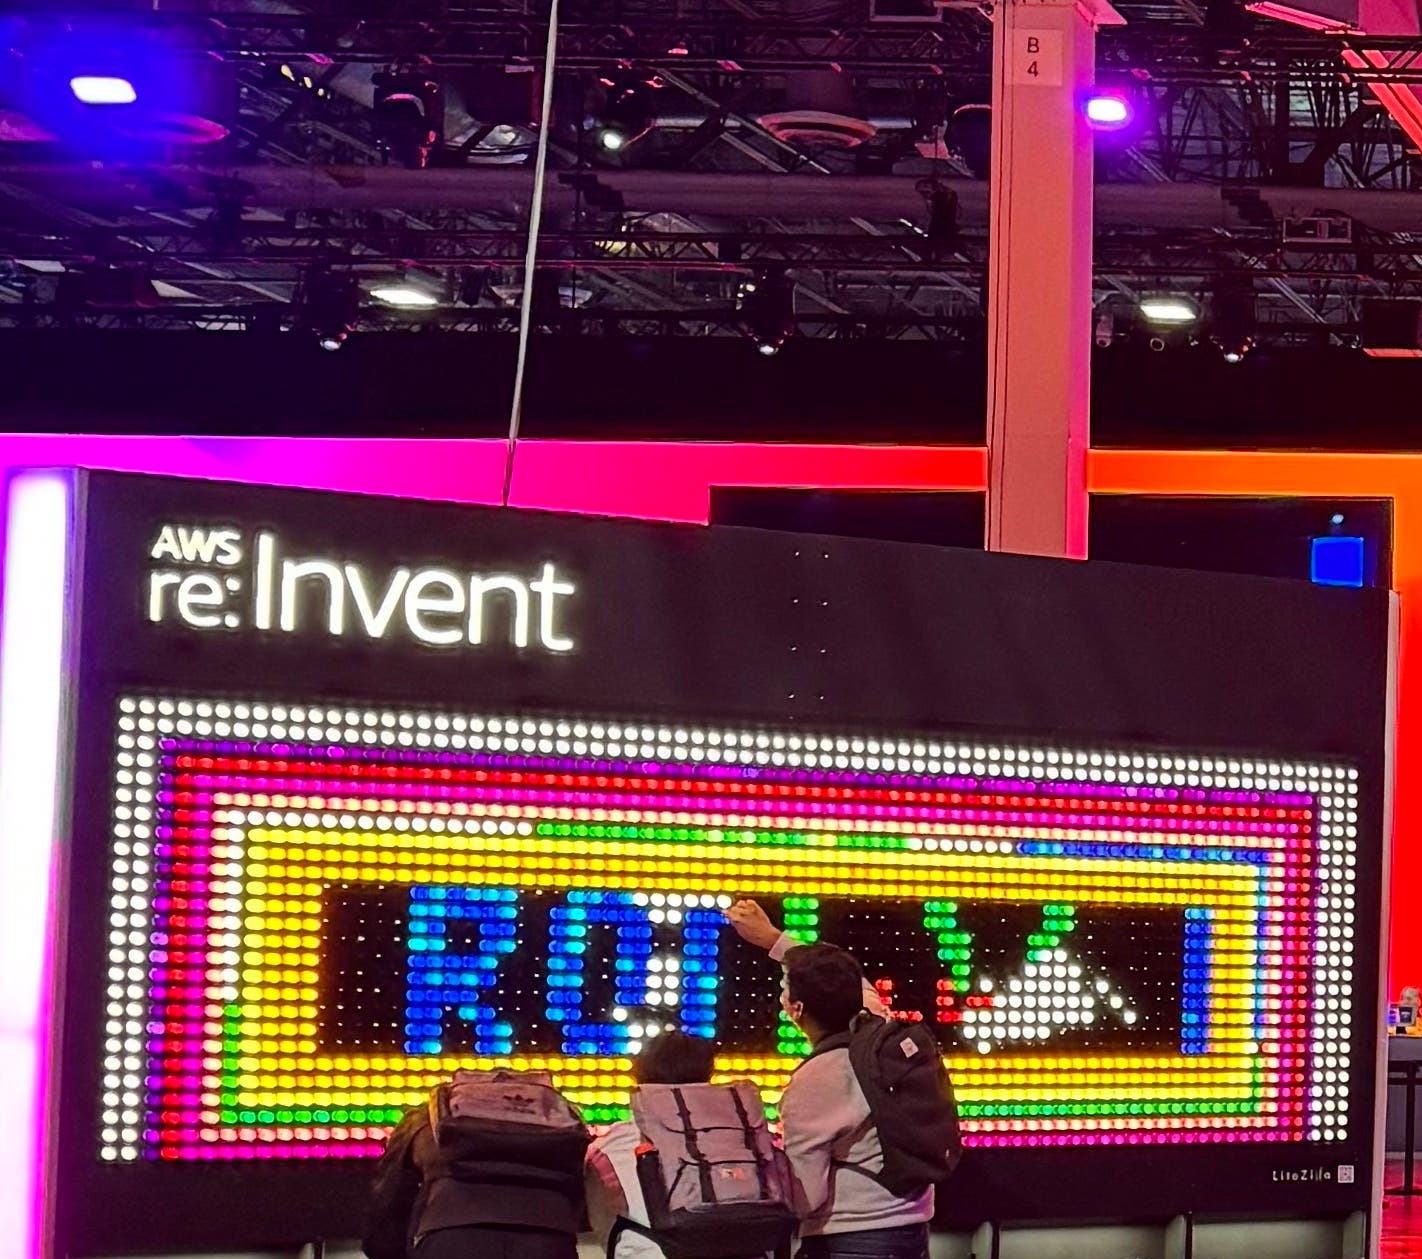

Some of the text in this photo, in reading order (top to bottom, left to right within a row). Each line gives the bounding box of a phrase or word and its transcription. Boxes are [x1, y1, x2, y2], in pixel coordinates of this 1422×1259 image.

[1026, 37, 1039, 53] B
[1026, 61, 1039, 77] 4
[151, 526, 241, 565] AWS
[148, 530, 577, 653] re:Invent
